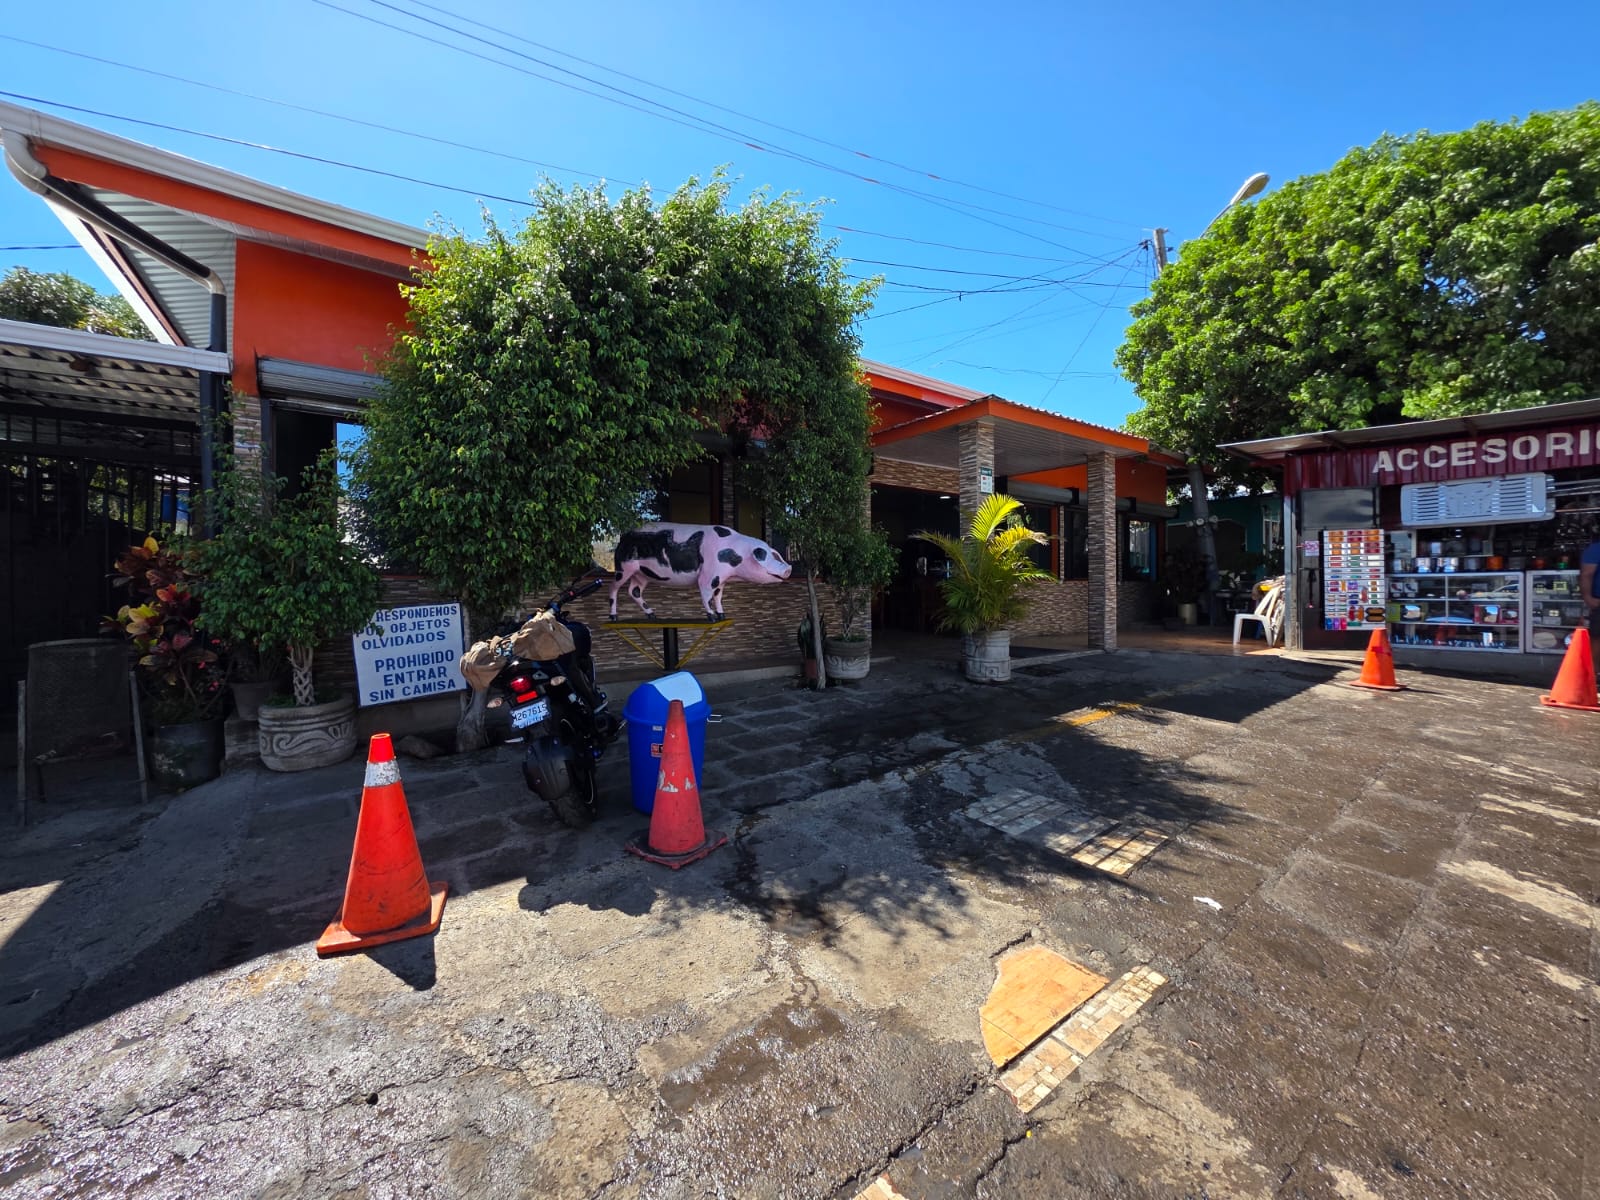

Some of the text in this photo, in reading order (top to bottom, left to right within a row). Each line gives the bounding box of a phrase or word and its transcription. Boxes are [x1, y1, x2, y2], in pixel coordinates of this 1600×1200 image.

[1372, 429, 1600, 473] ACCESORI
[376, 605, 457, 622] RESPONDEMOS
[390, 618, 450, 633] OBJETOS
[361, 630, 446, 650] OLVIDADOS
[374, 649, 454, 672] PROHIBIDO
[383, 666, 447, 686] ENTRAR
[369, 679, 456, 702] SIN CAMISA
